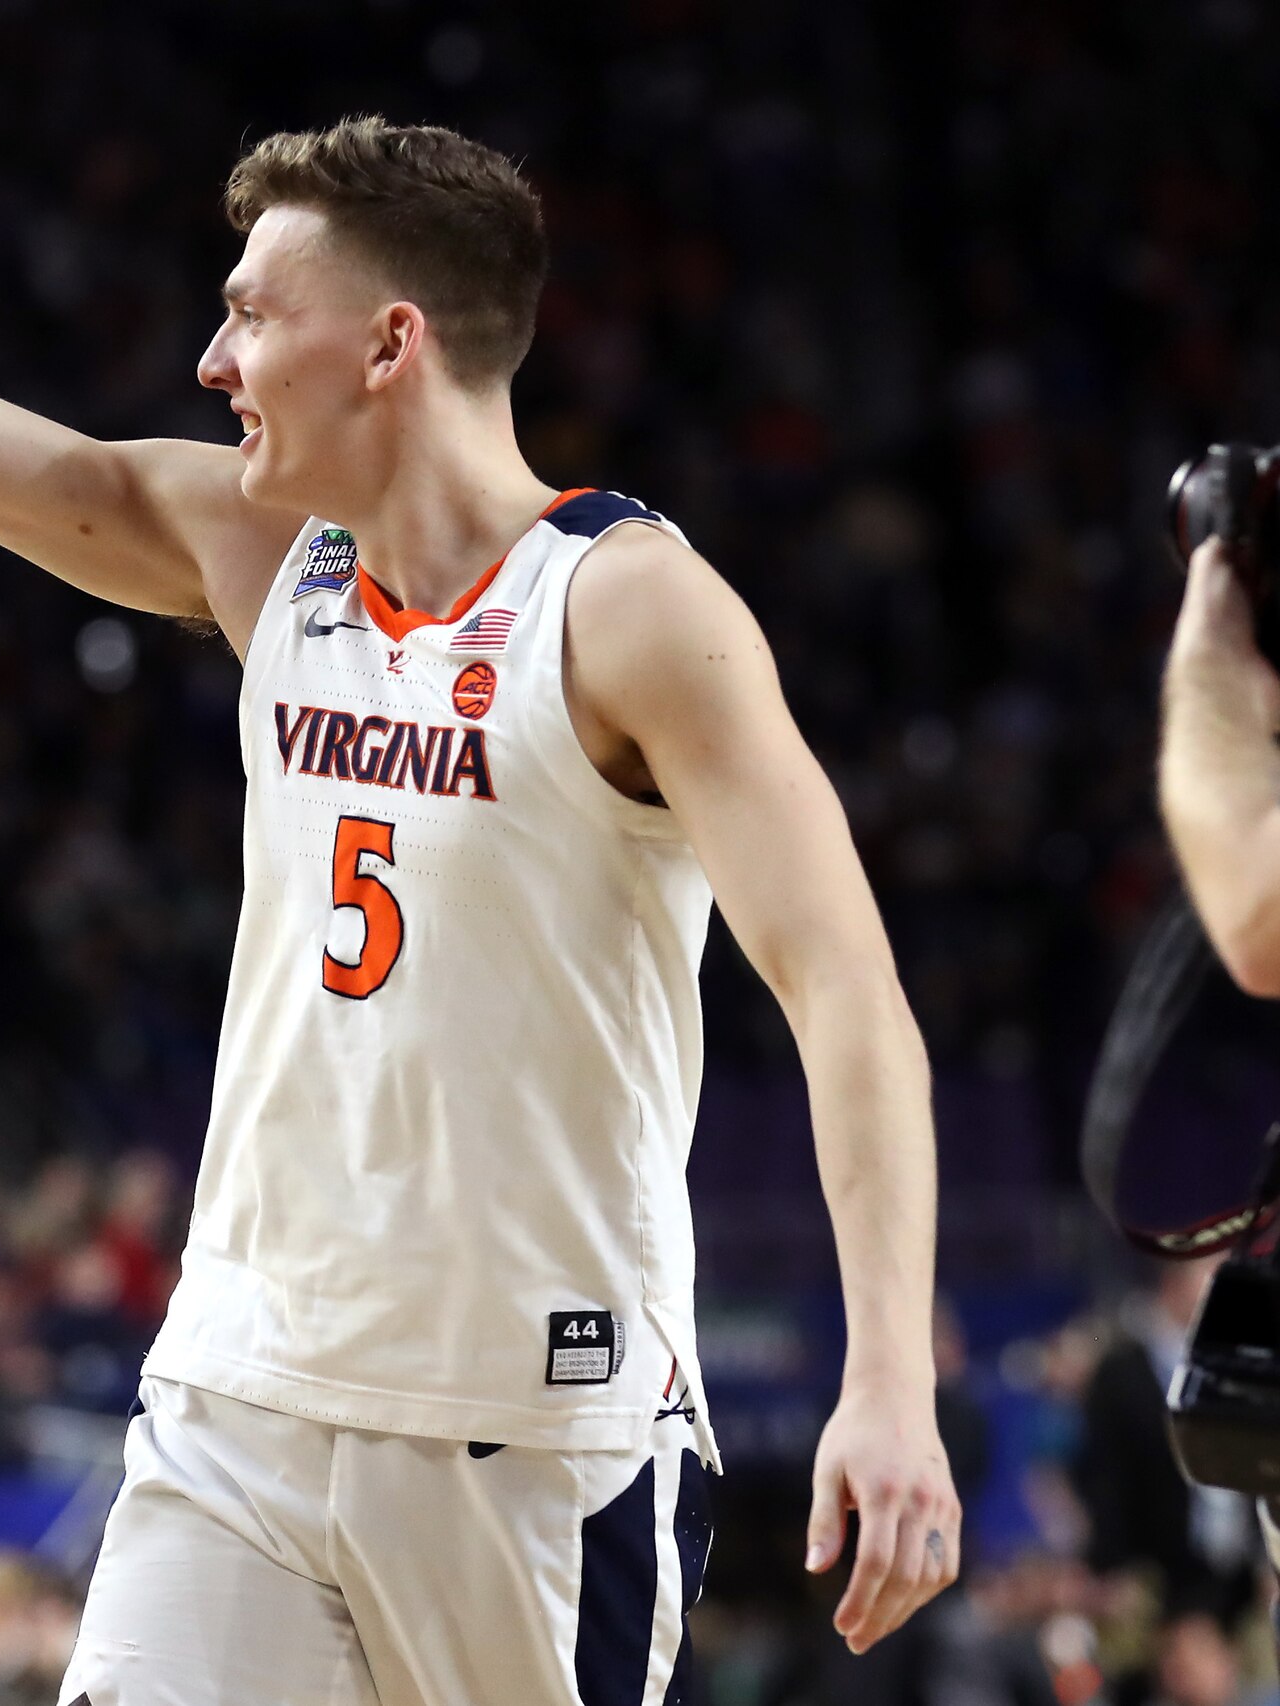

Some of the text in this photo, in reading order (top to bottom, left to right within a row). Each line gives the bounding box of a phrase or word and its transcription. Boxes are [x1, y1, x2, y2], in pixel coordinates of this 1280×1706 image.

[308, 544, 356, 563] FINAL
[302, 558, 351, 577] FOUR
[274, 701, 497, 801] VIRGINIA
[322, 815, 404, 1000] 5
[563, 1319, 599, 1340] 44
